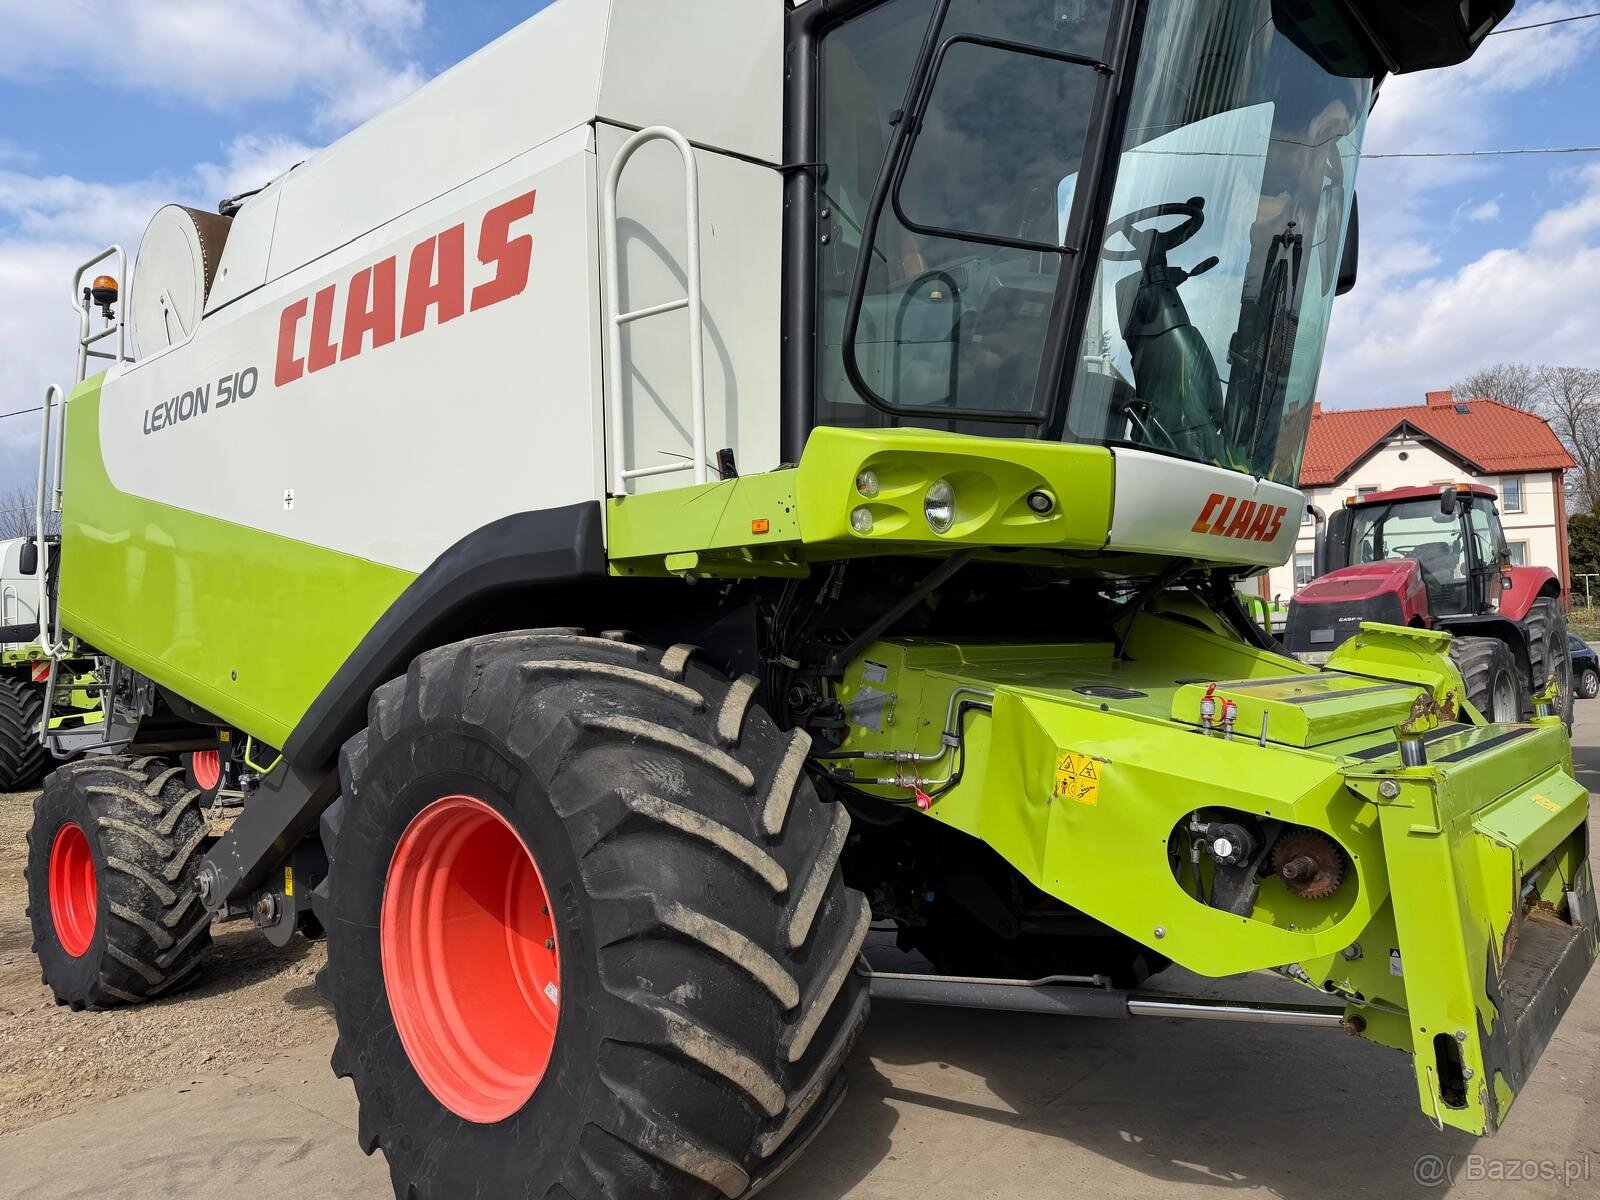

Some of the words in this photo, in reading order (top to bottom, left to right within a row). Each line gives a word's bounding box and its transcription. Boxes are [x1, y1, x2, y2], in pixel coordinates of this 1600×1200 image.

[274, 188, 537, 388] CLAAS
[142, 382, 211, 435] LEXION
[215, 366, 259, 409] 510
[1191, 493, 1288, 542] CLAAS
